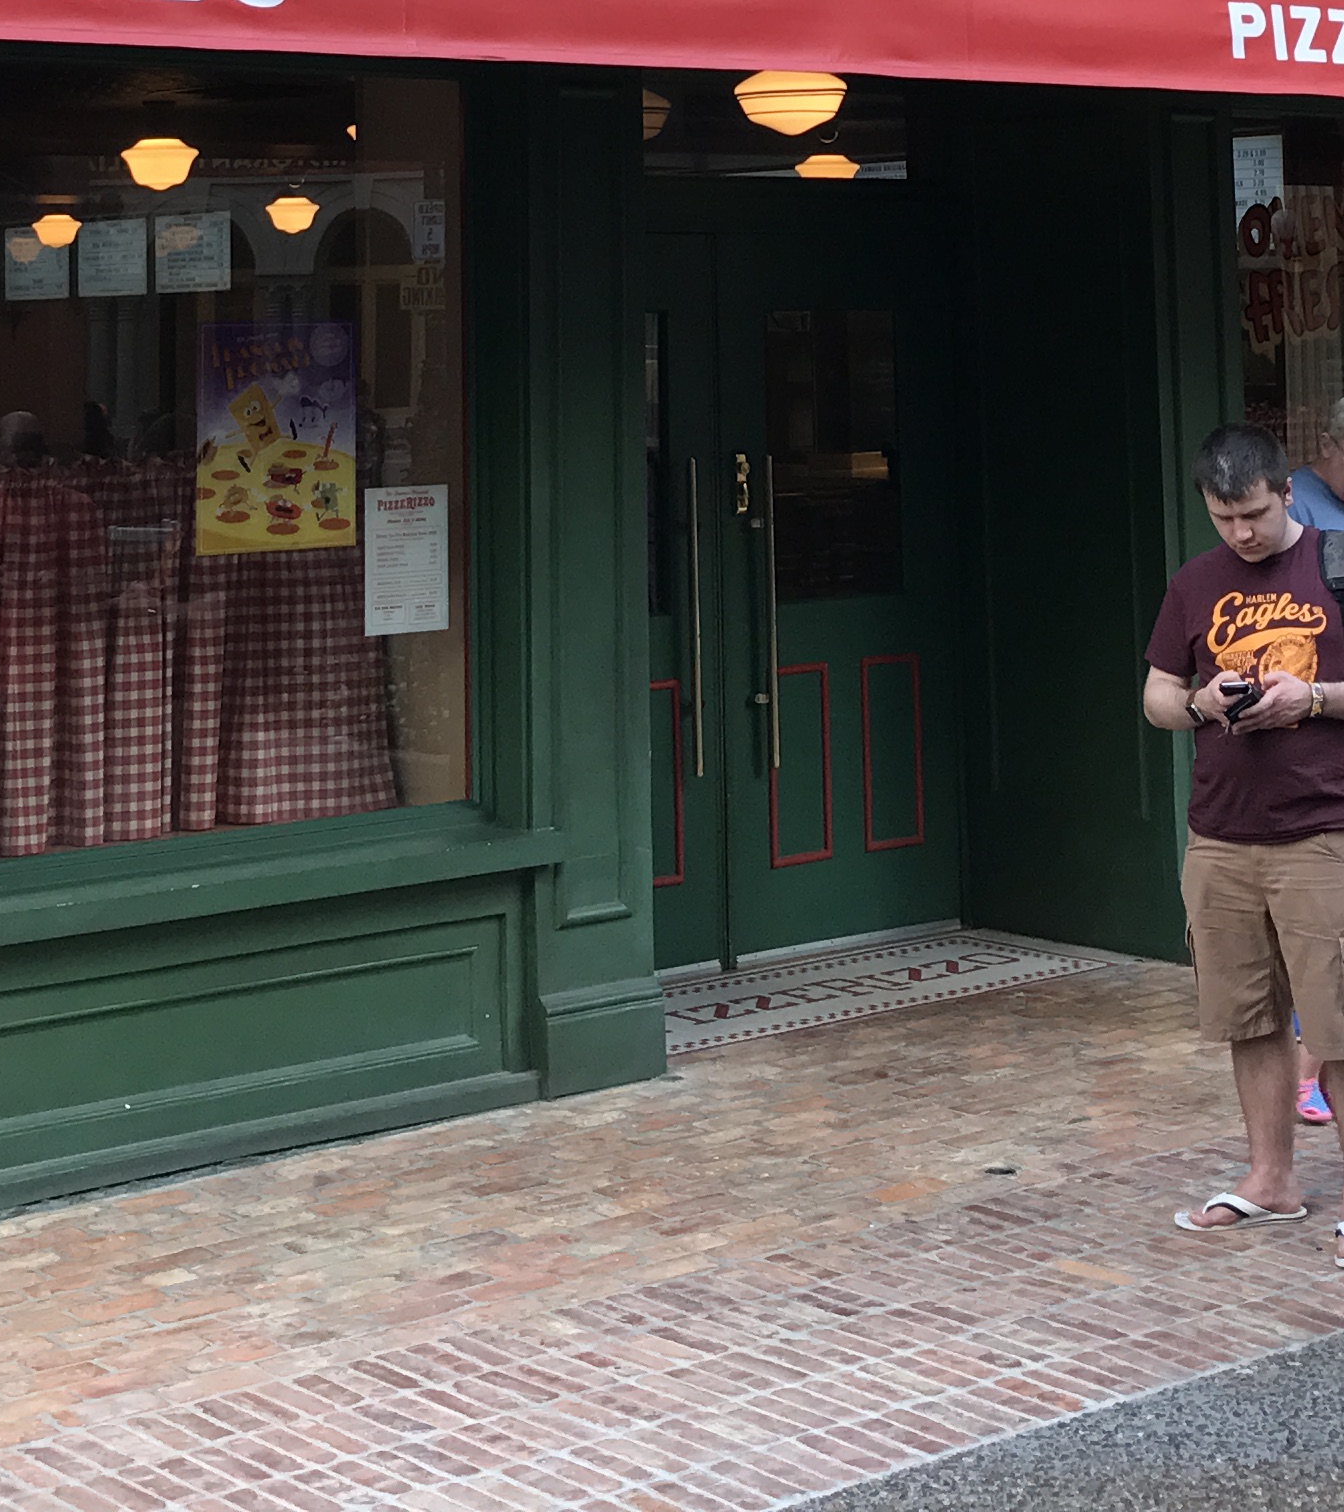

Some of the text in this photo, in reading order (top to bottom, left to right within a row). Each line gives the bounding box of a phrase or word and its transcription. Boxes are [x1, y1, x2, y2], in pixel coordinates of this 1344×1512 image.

[1207, 591, 1317, 654] Eagles
[1245, 593, 1277, 604] HARLEM
[665, 952, 1020, 1034] IZZERIZZO
